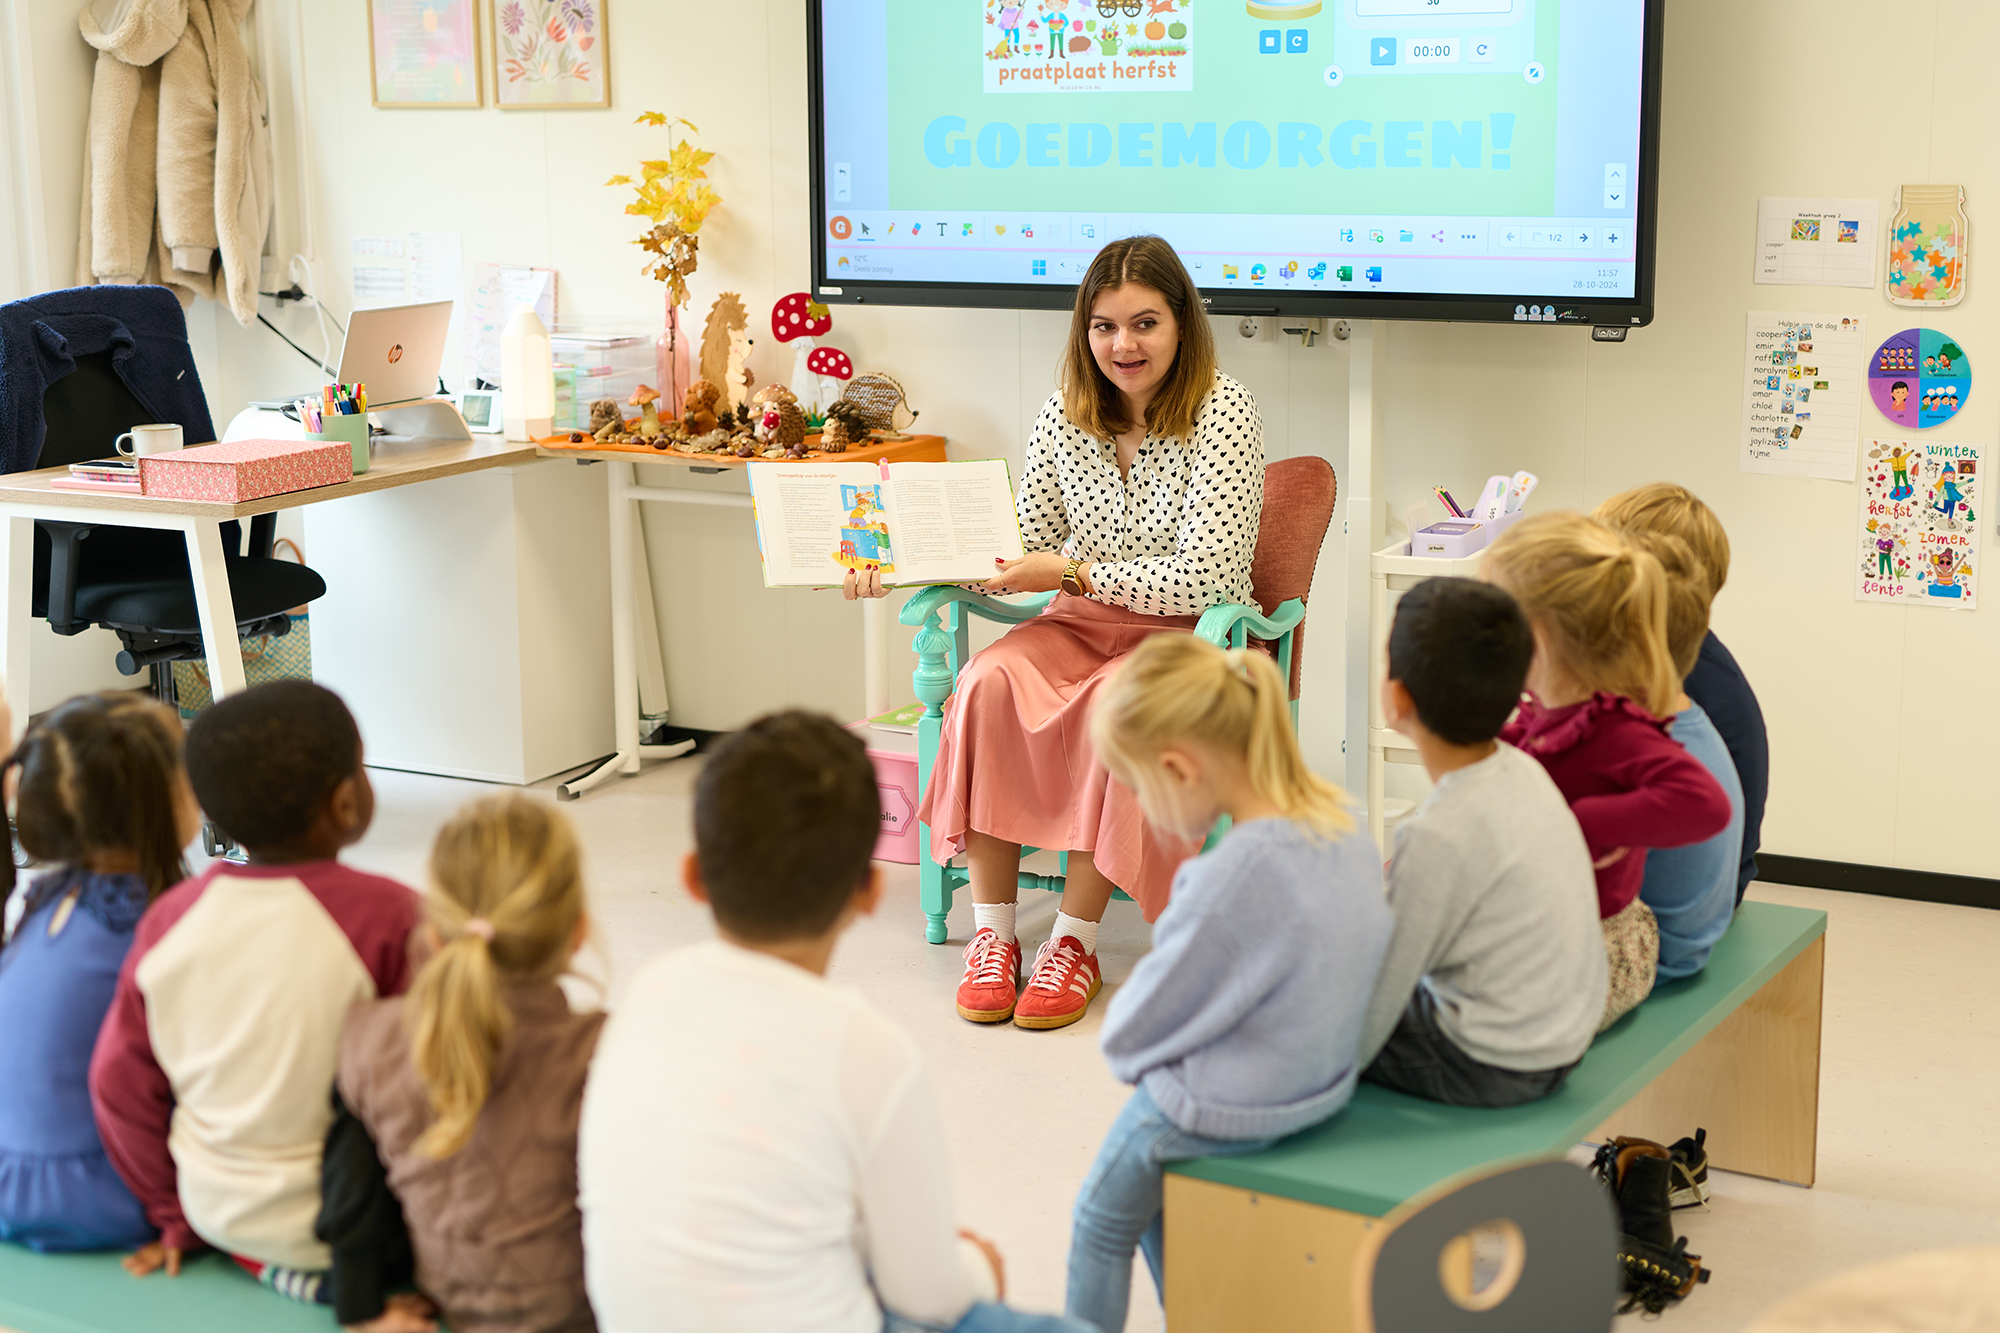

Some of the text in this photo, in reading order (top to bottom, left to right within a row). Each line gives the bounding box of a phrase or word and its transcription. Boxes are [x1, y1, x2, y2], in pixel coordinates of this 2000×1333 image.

[1413, 45, 1451, 57] 00:00
[999, 60, 1177, 85] praatplaat herfst
[923, 112, 1516, 170] GOEDEMORGEN!
[1549, 234, 1562, 242] 1/2
[854, 265, 893, 274] Deels zonnig
[1597, 269, 1618, 277] 11:57
[1572, 281, 1618, 289] 28-10-2024
[1778, 320, 1799, 328] Hulpje
[1825, 322, 1838, 331] dag
[1756, 331, 1783, 339] cooper
[1755, 342, 1774, 350] emir
[1753, 366, 1788, 376] noralynn
[1753, 377, 1767, 386] noé
[1751, 402, 1773, 410] chloë
[1750, 413, 1789, 423] charlotte
[1749, 449, 1771, 459] tijme
[1862, 580, 1904, 597] lente
